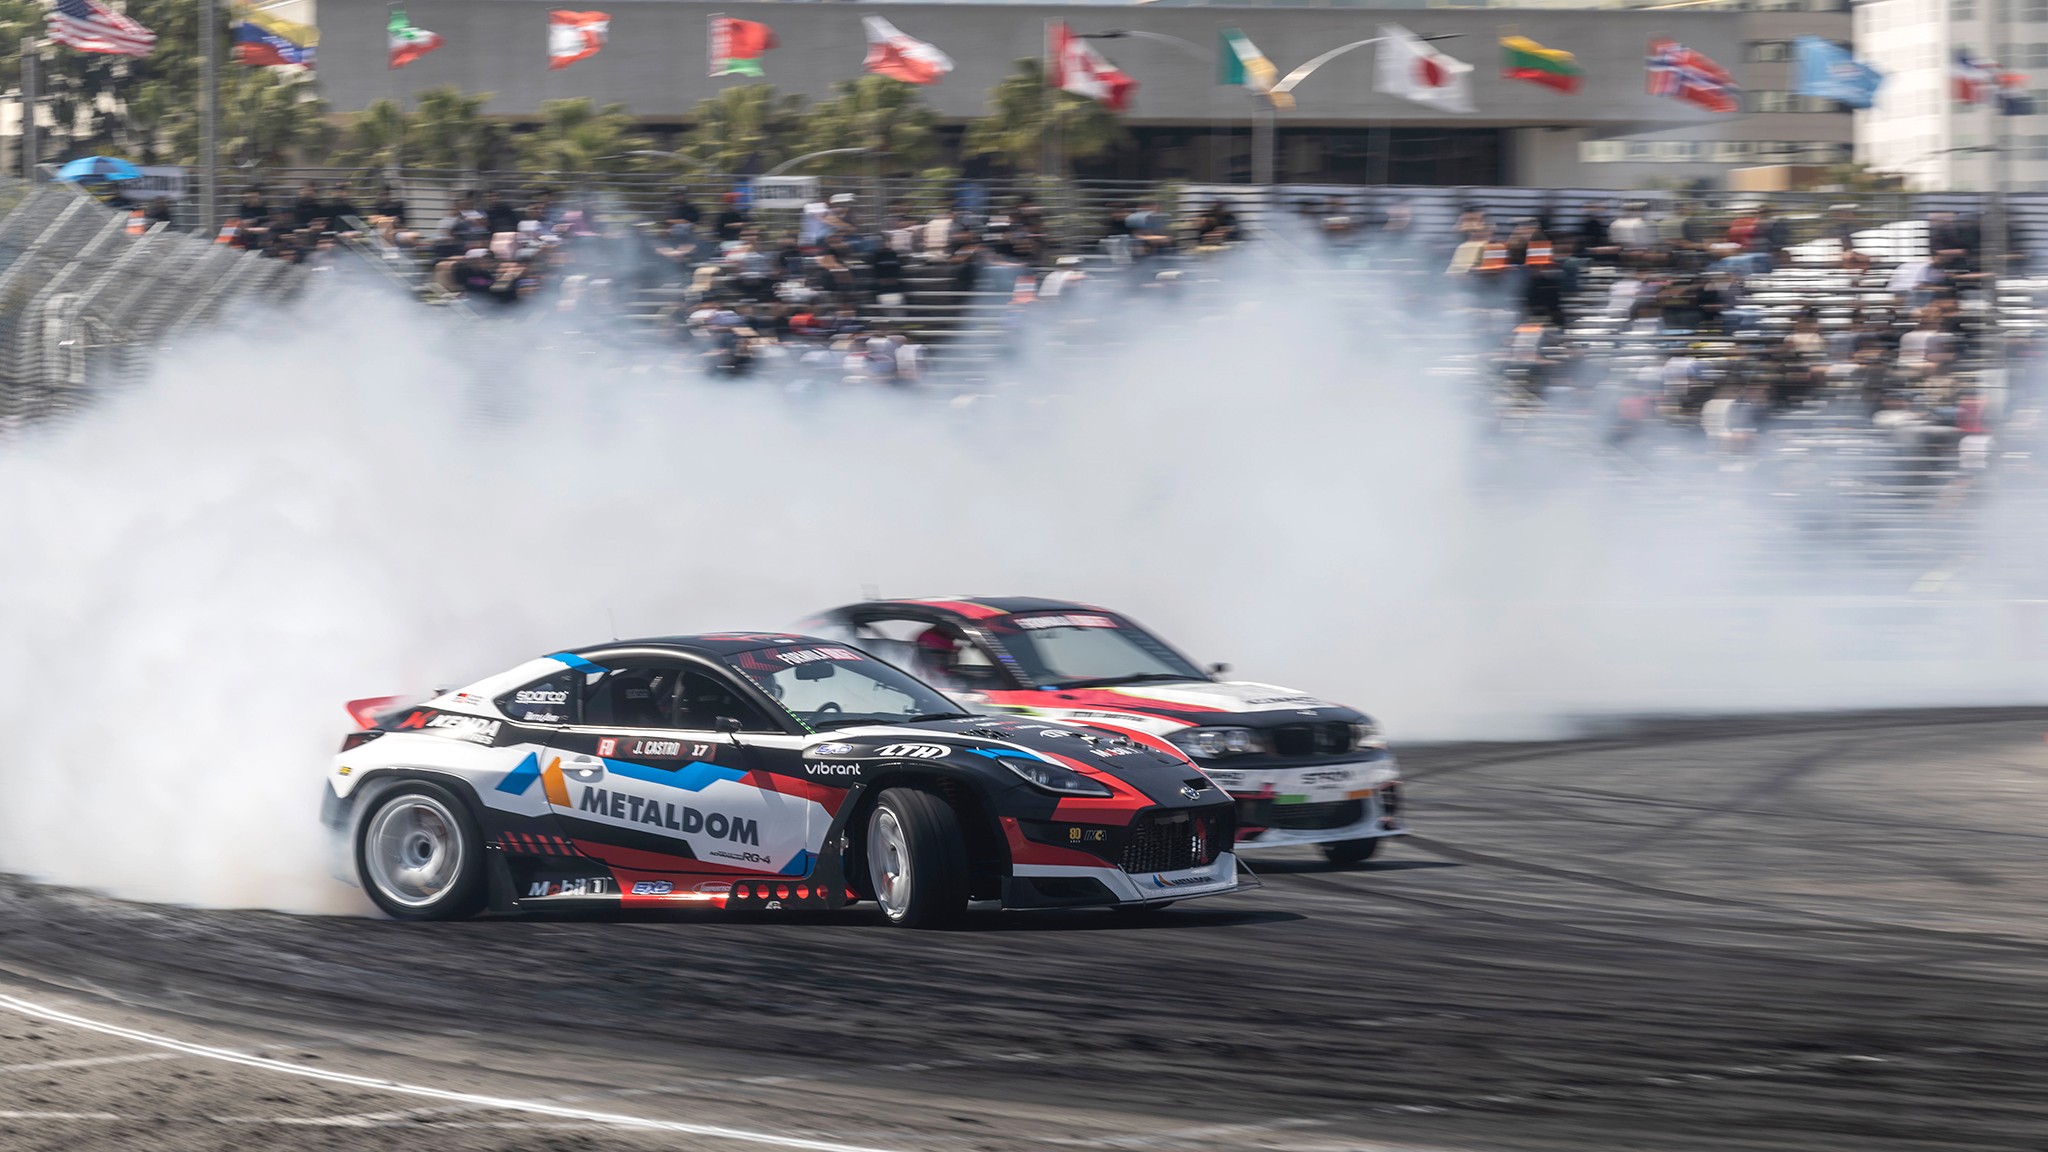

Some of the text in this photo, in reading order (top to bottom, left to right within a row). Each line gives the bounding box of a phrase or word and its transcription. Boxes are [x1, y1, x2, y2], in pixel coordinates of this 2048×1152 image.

[515, 690, 568, 704] sparco
[426, 714, 502, 737] KENDA
[632, 741, 681, 756] J. CASTRO
[691, 744, 709, 757] 17
[877, 743, 939, 759] LTH
[804, 761, 862, 776] vibrant
[579, 786, 760, 847] METALDOM
[1069, 827, 1081, 840] 80
[743, 852, 771, 864] RG-4
[528, 878, 587, 896] Mobil
